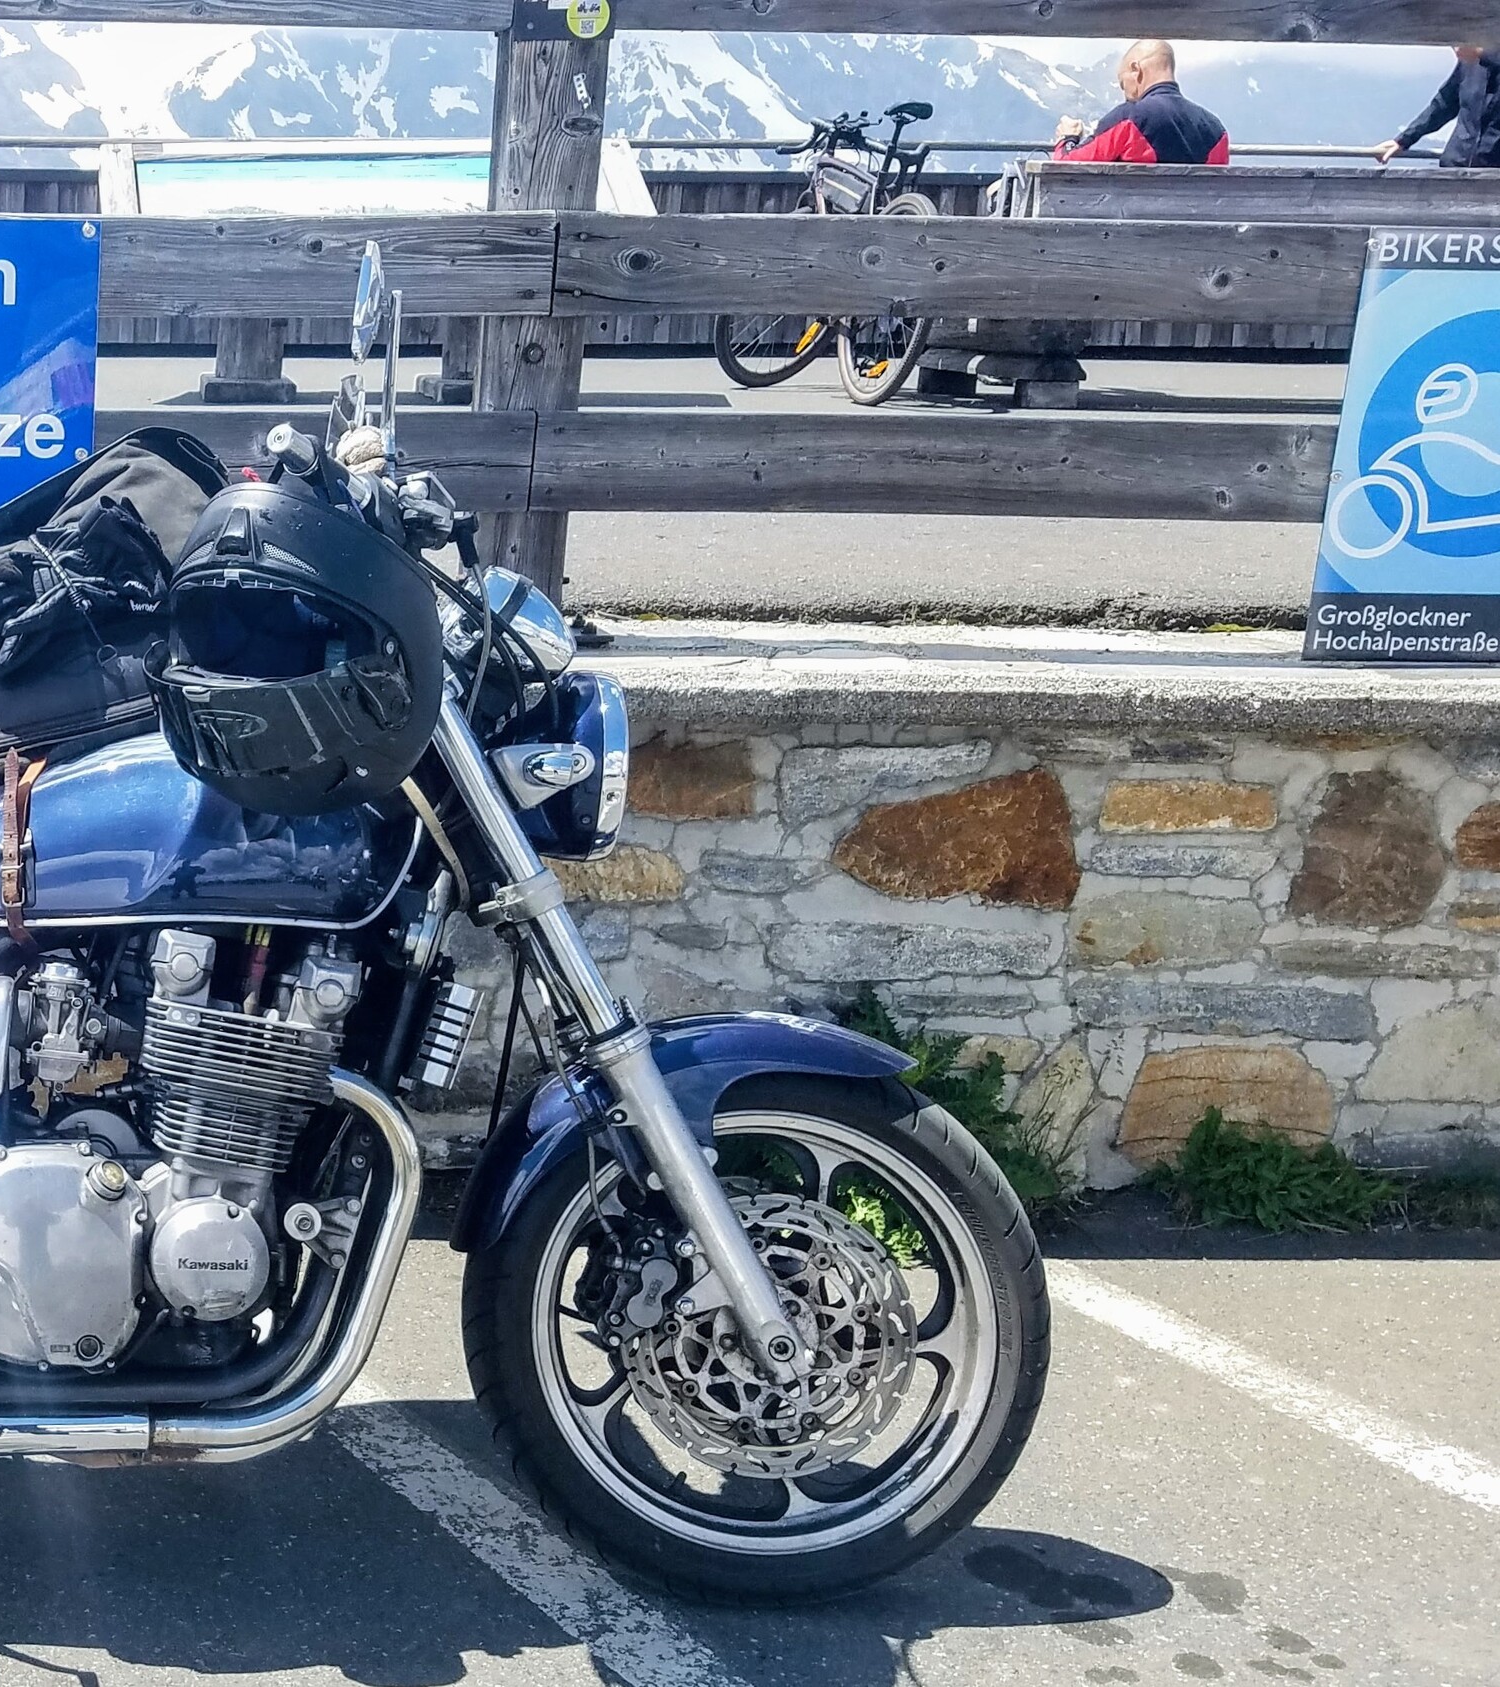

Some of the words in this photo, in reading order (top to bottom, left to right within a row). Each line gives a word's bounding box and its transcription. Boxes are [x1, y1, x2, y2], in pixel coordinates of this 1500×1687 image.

[1317, 604, 1472, 632] Großglockner
[1312, 629, 1499, 657] Hochalpenstraße
[177, 1257, 249, 1271] Kawasaki
